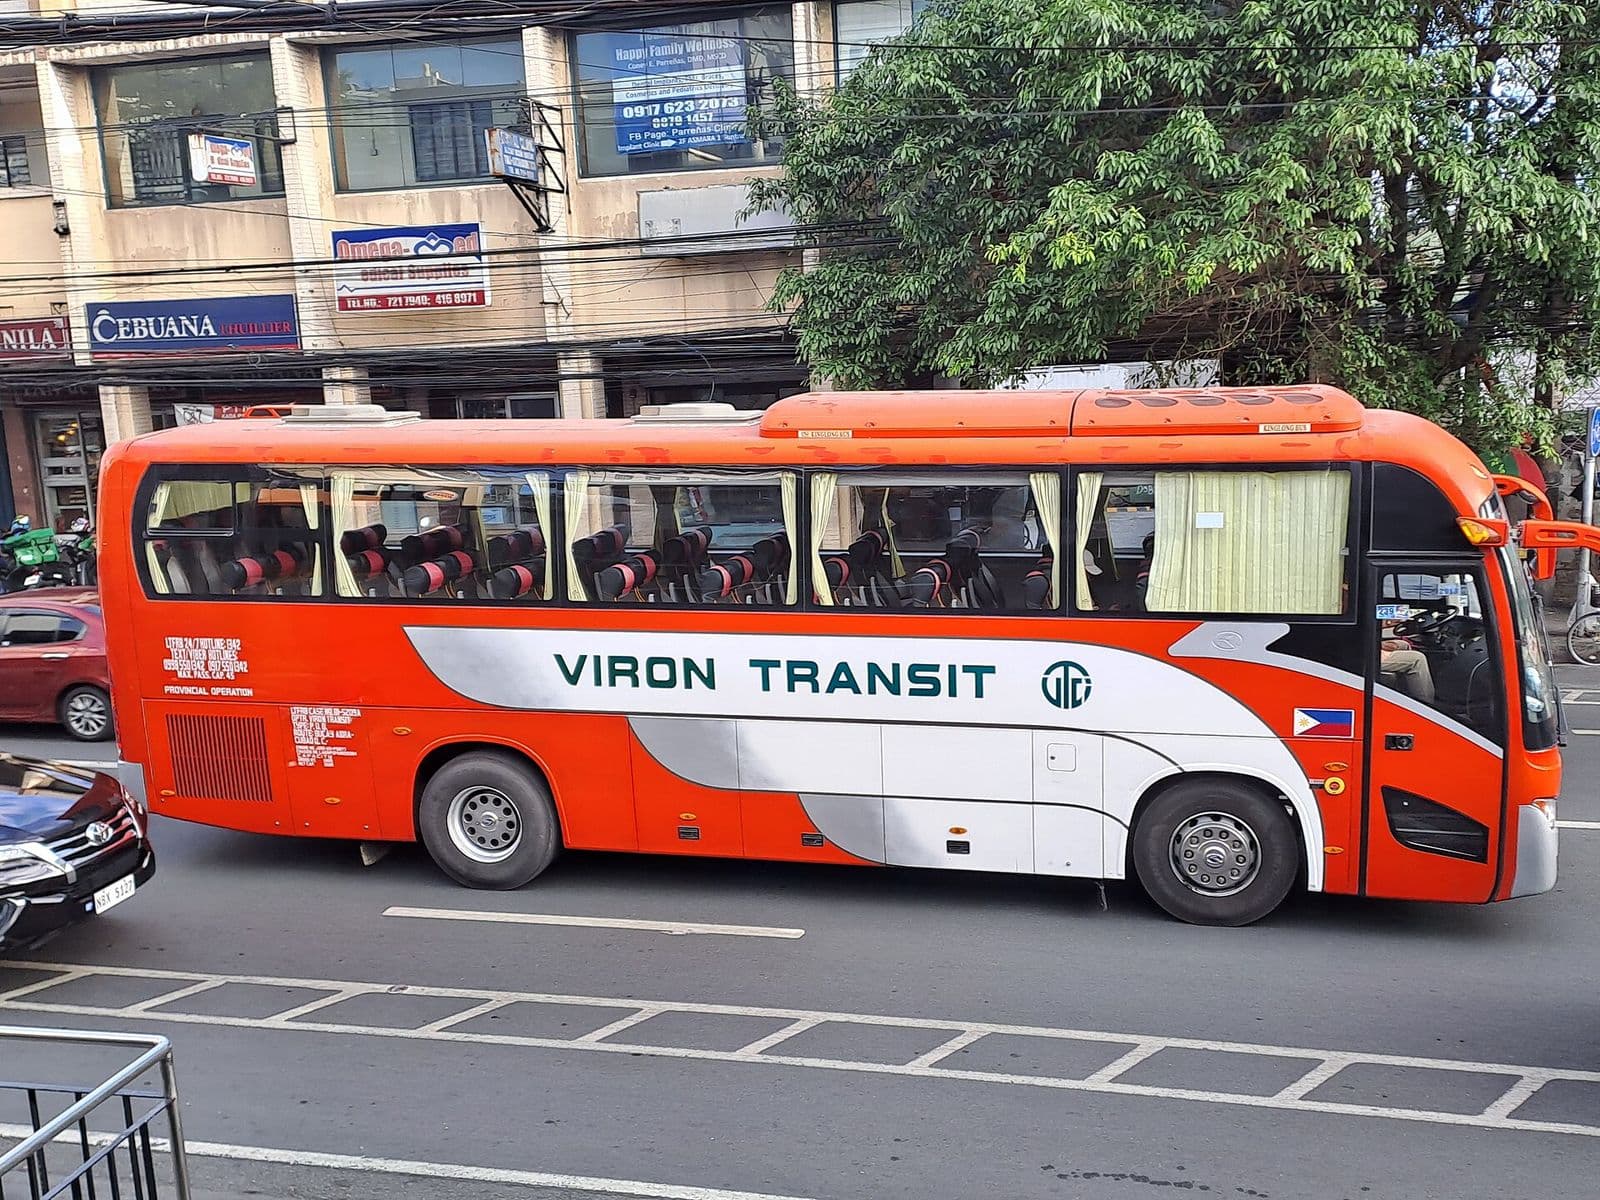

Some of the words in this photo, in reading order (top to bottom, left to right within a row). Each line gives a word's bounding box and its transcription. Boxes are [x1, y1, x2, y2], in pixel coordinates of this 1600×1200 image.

[616, 46, 647, 61] Happy
[650, 42, 683, 56] Family
[685, 37, 736, 52] Wellness
[625, 89, 657, 99] Cosmetics
[659, 87, 671, 95] and
[623, 104, 660, 118] 0917
[664, 100, 695, 114] 623
[698, 97, 740, 110] 2073
[687, 112, 713, 124] 1457
[629, 132, 642, 141] FB
[643, 140, 660, 148] Clinic
[454, 292, 478, 304] 8971
[93, 310, 217, 342] CEBUANA
[553, 654, 717, 690] VIRON
[749, 659, 996, 699] TRANSIT
[164, 685, 209, 696] PROVINCIAL
[211, 687, 254, 697] OPERATION
